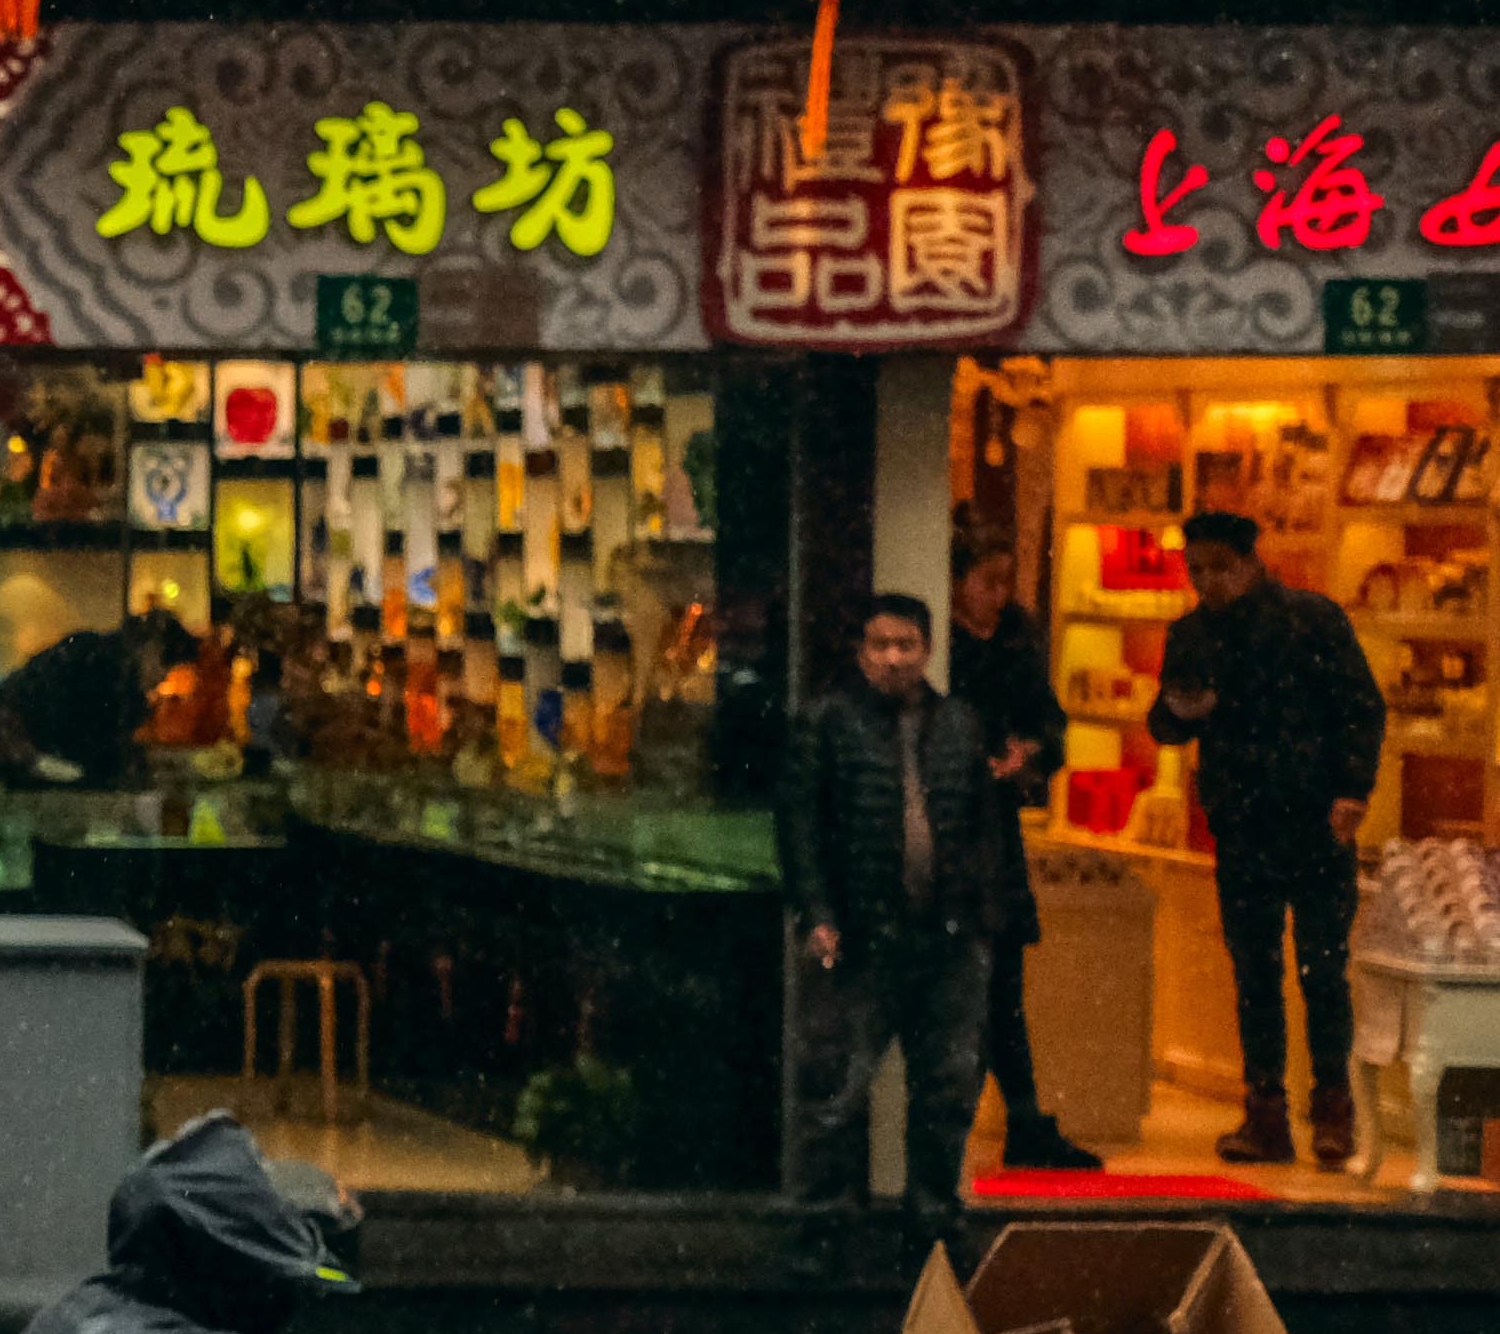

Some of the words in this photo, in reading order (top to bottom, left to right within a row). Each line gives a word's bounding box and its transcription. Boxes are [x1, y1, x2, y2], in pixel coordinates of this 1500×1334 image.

[95, 101, 616, 256] 琉璃坊
[341, 281, 392, 324] 62
[1351, 285, 1400, 327] 62
